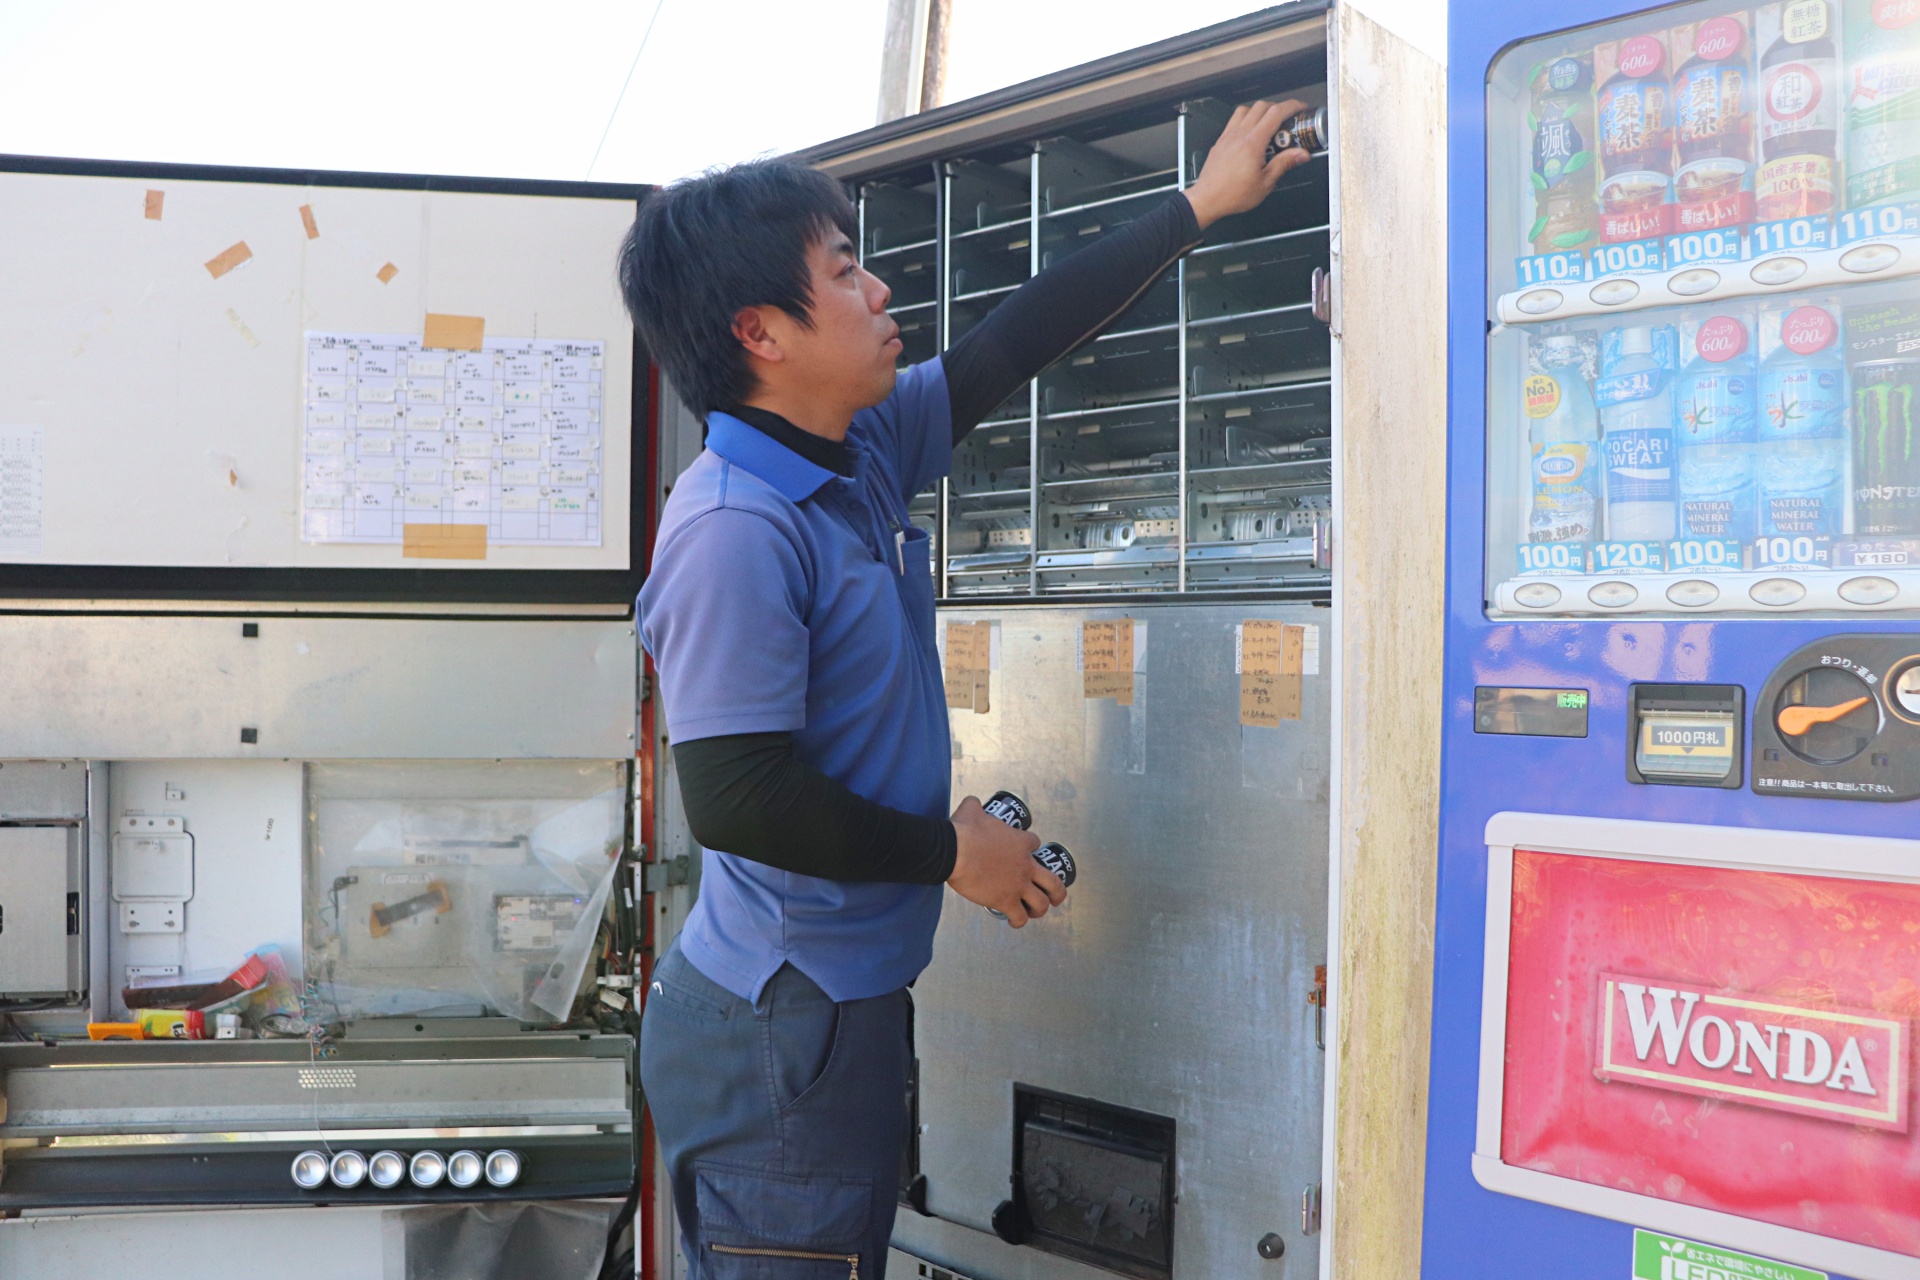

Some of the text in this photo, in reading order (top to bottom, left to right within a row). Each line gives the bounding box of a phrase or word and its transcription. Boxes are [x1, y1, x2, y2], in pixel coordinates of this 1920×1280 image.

[1790, 20, 1822, 39] 紅茶
[1779, 75, 1801, 95] 和
[1691, 77, 1717, 135] 麦茶
[1776, 95, 1803, 111] 紅茶
[1614, 93, 1640, 150] 麦茶
[1762, 161, 1818, 181] 国産茶葉
[1526, 381, 1555, 398] No.1
[1607, 438, 1669, 454] POCARI
[1607, 451, 1663, 467] SWEAT
[1537, 485, 1584, 495] LEMON
[1685, 501, 1731, 511] NATURAL
[1770, 498, 1822, 509] NATURAL
[1687, 512, 1730, 522] MINERAL
[1771, 510, 1820, 519] MINERAL
[1690, 524, 1725, 534] WATER
[1776, 521, 1816, 532] WATER
[1856, 553, 1906, 564] ¥180
[1556, 693, 1587, 709] 販売中
[1657, 730, 1719, 745] 1000円札
[984, 799, 1023, 830] BLAC
[1036, 847, 1067, 884] BLAC
[1618, 981, 1878, 1096] WONDA
